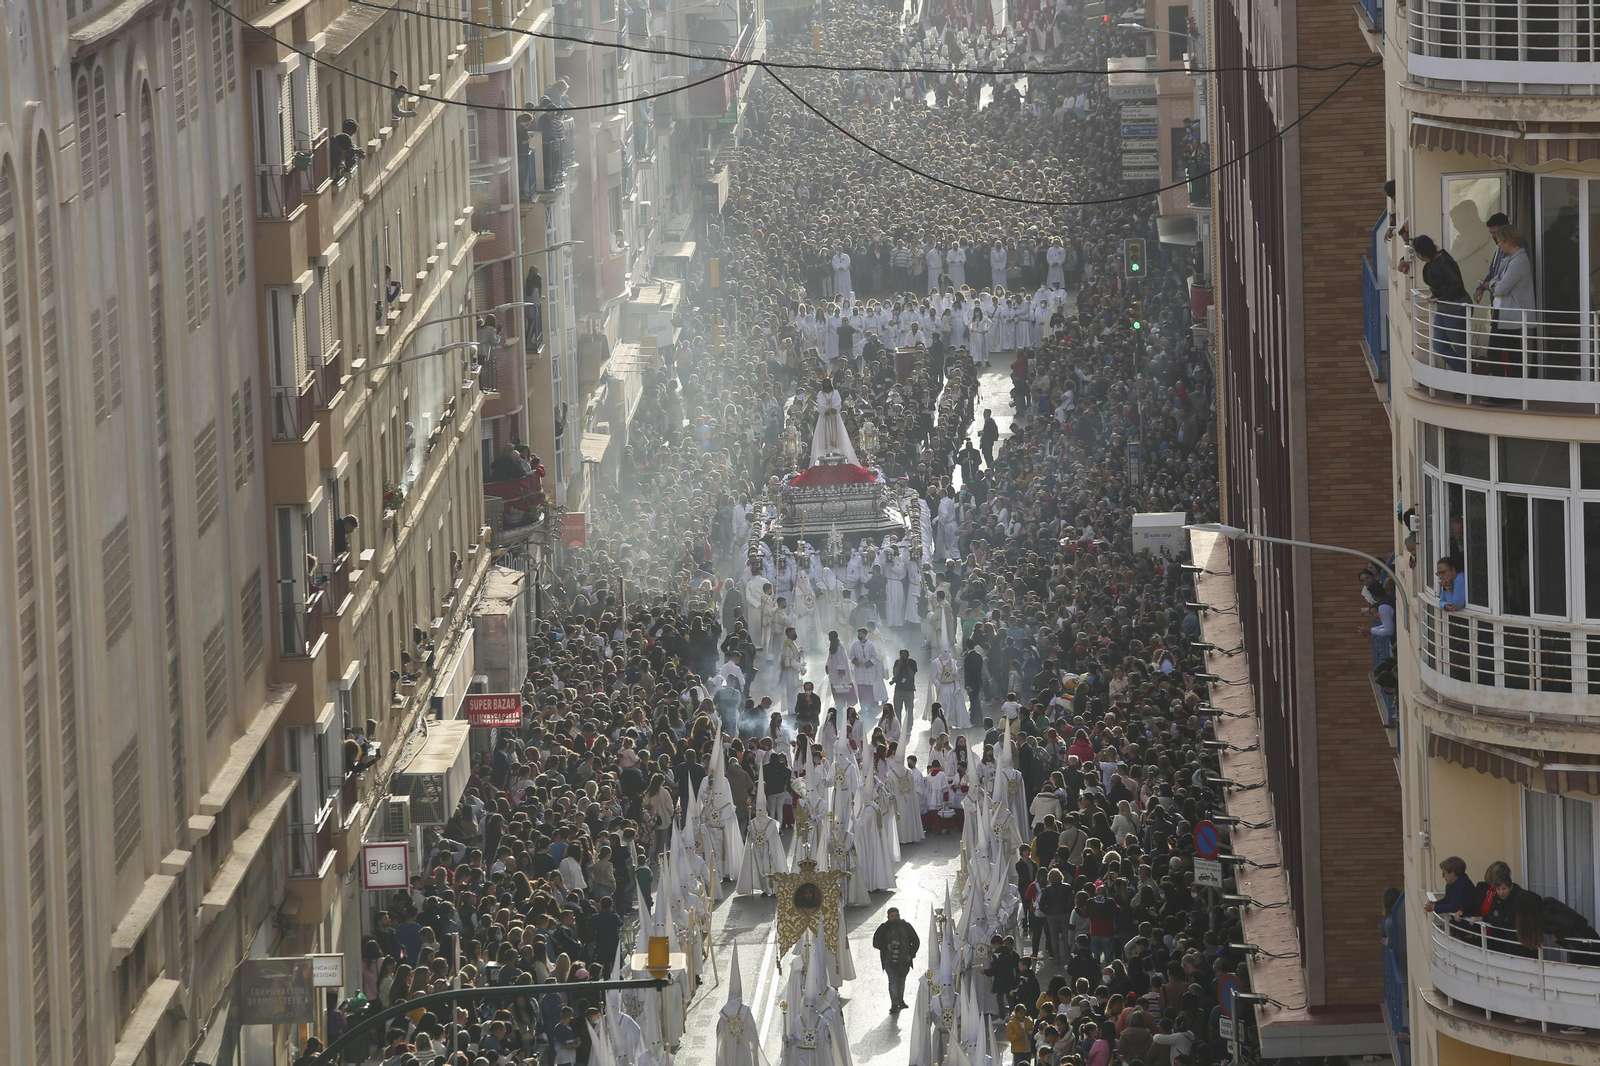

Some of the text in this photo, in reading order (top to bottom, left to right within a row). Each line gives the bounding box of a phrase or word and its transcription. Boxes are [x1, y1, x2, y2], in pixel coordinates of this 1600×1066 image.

[470, 698, 515, 710] SUPER BAZAR
[379, 862, 403, 871] Fixea
